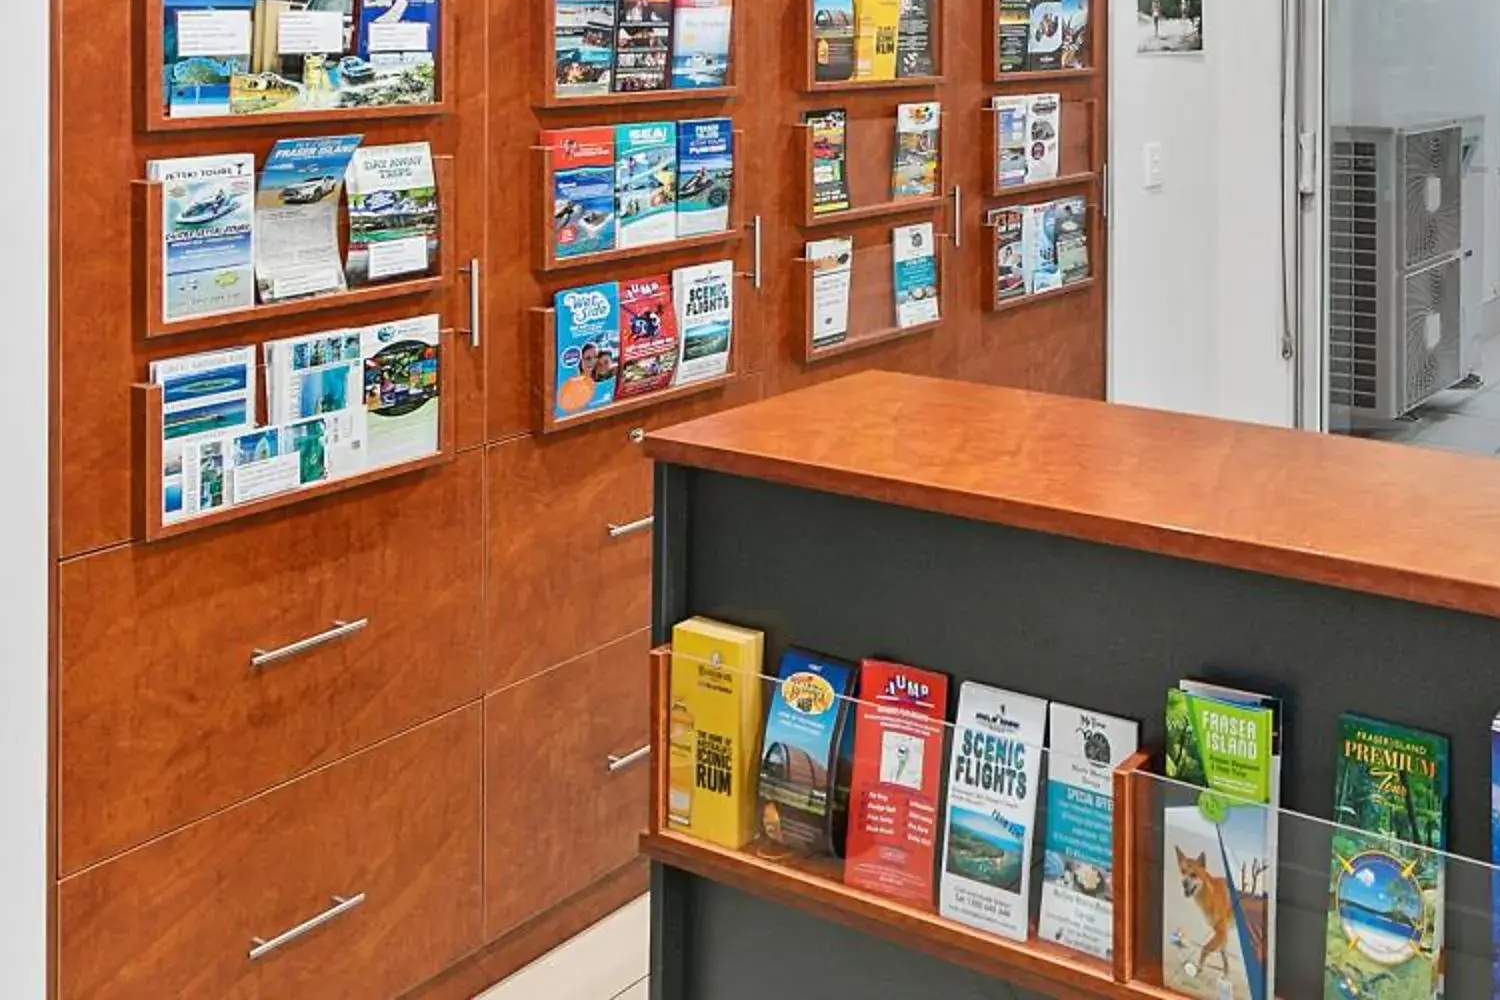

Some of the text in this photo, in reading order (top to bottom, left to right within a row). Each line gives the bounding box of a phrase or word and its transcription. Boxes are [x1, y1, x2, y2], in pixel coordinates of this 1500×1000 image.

[685, 297, 729, 317] FLIGHTS
[689, 283, 727, 301] SCENIC
[885, 674, 929, 698] JUMP
[1202, 710, 1256, 740] FRASER
[962, 728, 1026, 770] SCENIC
[1206, 732, 1257, 760] ISLAND
[1344, 739, 1437, 778] PREMIUM
[696, 763, 732, 798] RUM
[955, 755, 1027, 800] FLIGHTS
